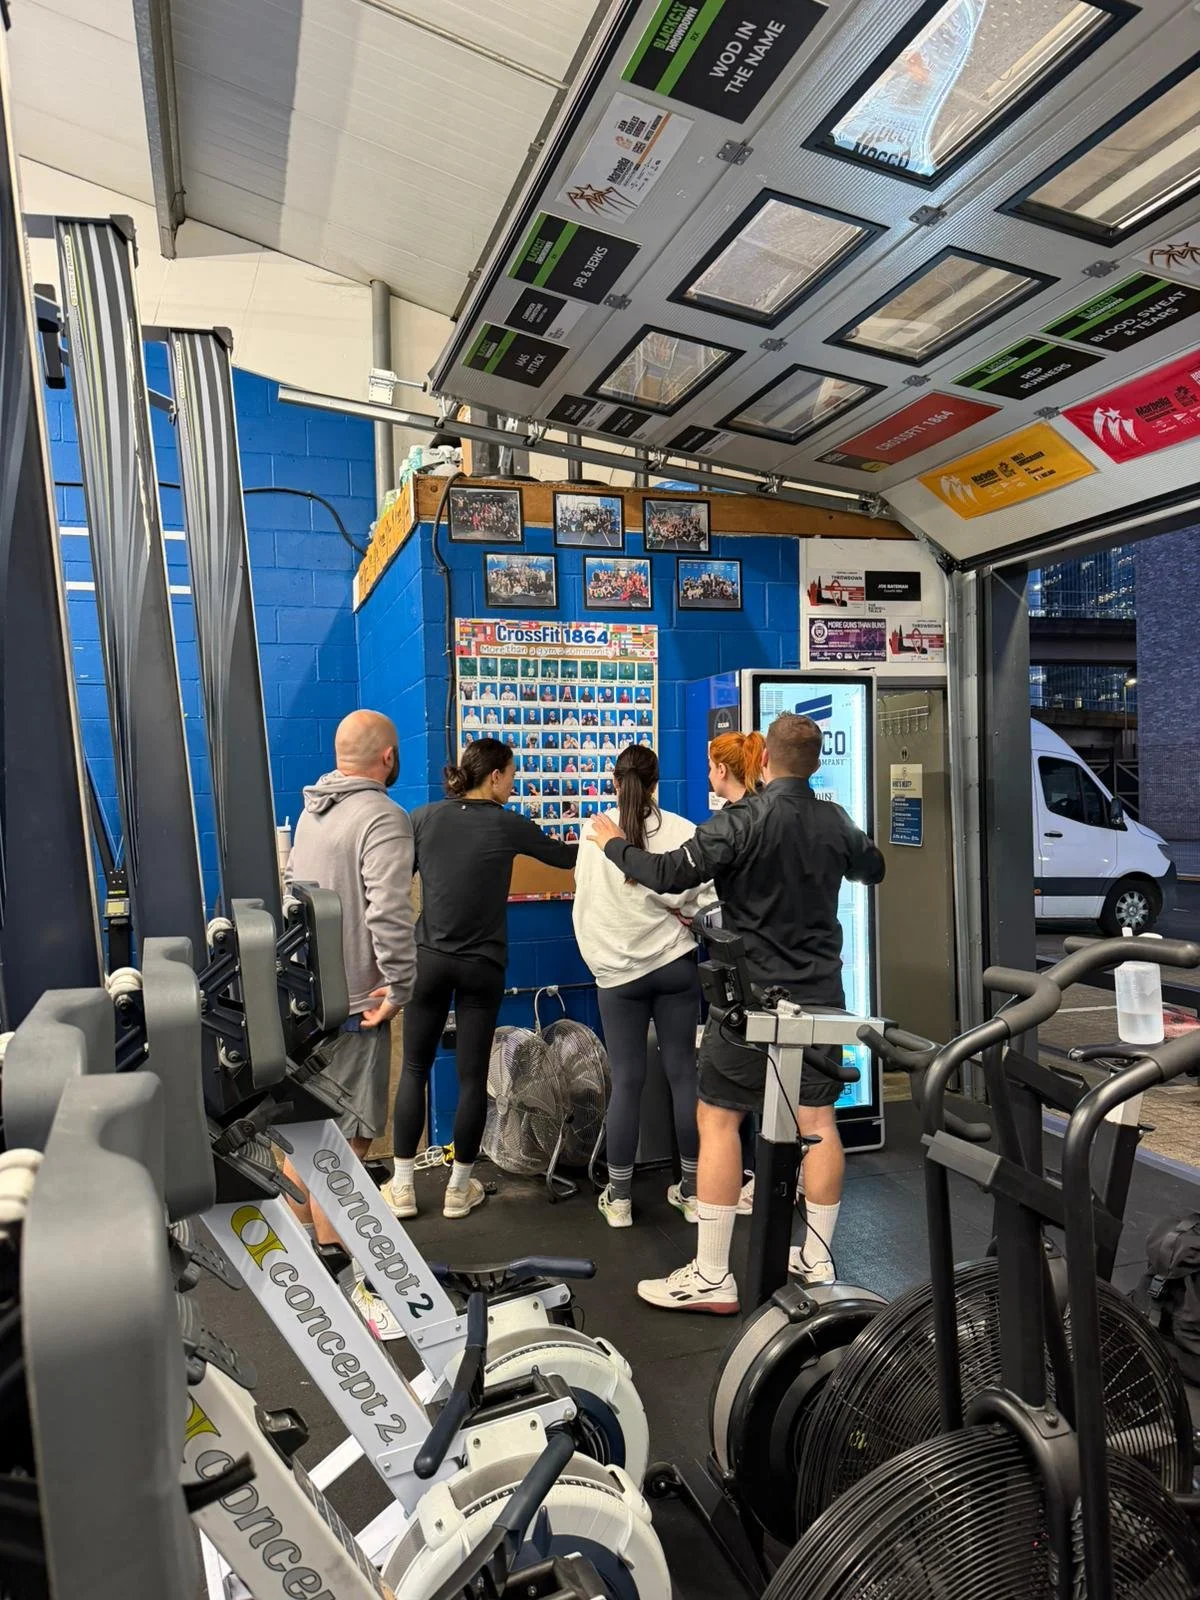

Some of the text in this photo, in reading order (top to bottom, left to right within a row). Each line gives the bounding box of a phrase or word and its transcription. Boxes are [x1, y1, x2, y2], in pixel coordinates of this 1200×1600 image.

[654, 1, 690, 49] BLACKCAT
[665, 6, 699, 52] THROWDOWN
[709, 20, 758, 79] WOD IN
[724, 20, 786, 96] THE NAME
[624, 116, 640, 134] CHARLES
[606, 157, 631, 184] Marbella
[573, 277, 588, 288] PB
[586, 246, 608, 271] JERKS
[1137, 290, 1187, 318] SWEAT
[1133, 307, 1179, 330] TEARS
[526, 353, 546, 375] ATTACK
[1020, 367, 1043, 379] REP
[1020, 363, 1072, 389] RUNNERS
[876, 410, 955, 450] CROSSFIT 1864
[496, 625, 609, 644] CrossFit 1864
[506, 645, 527, 654] than
